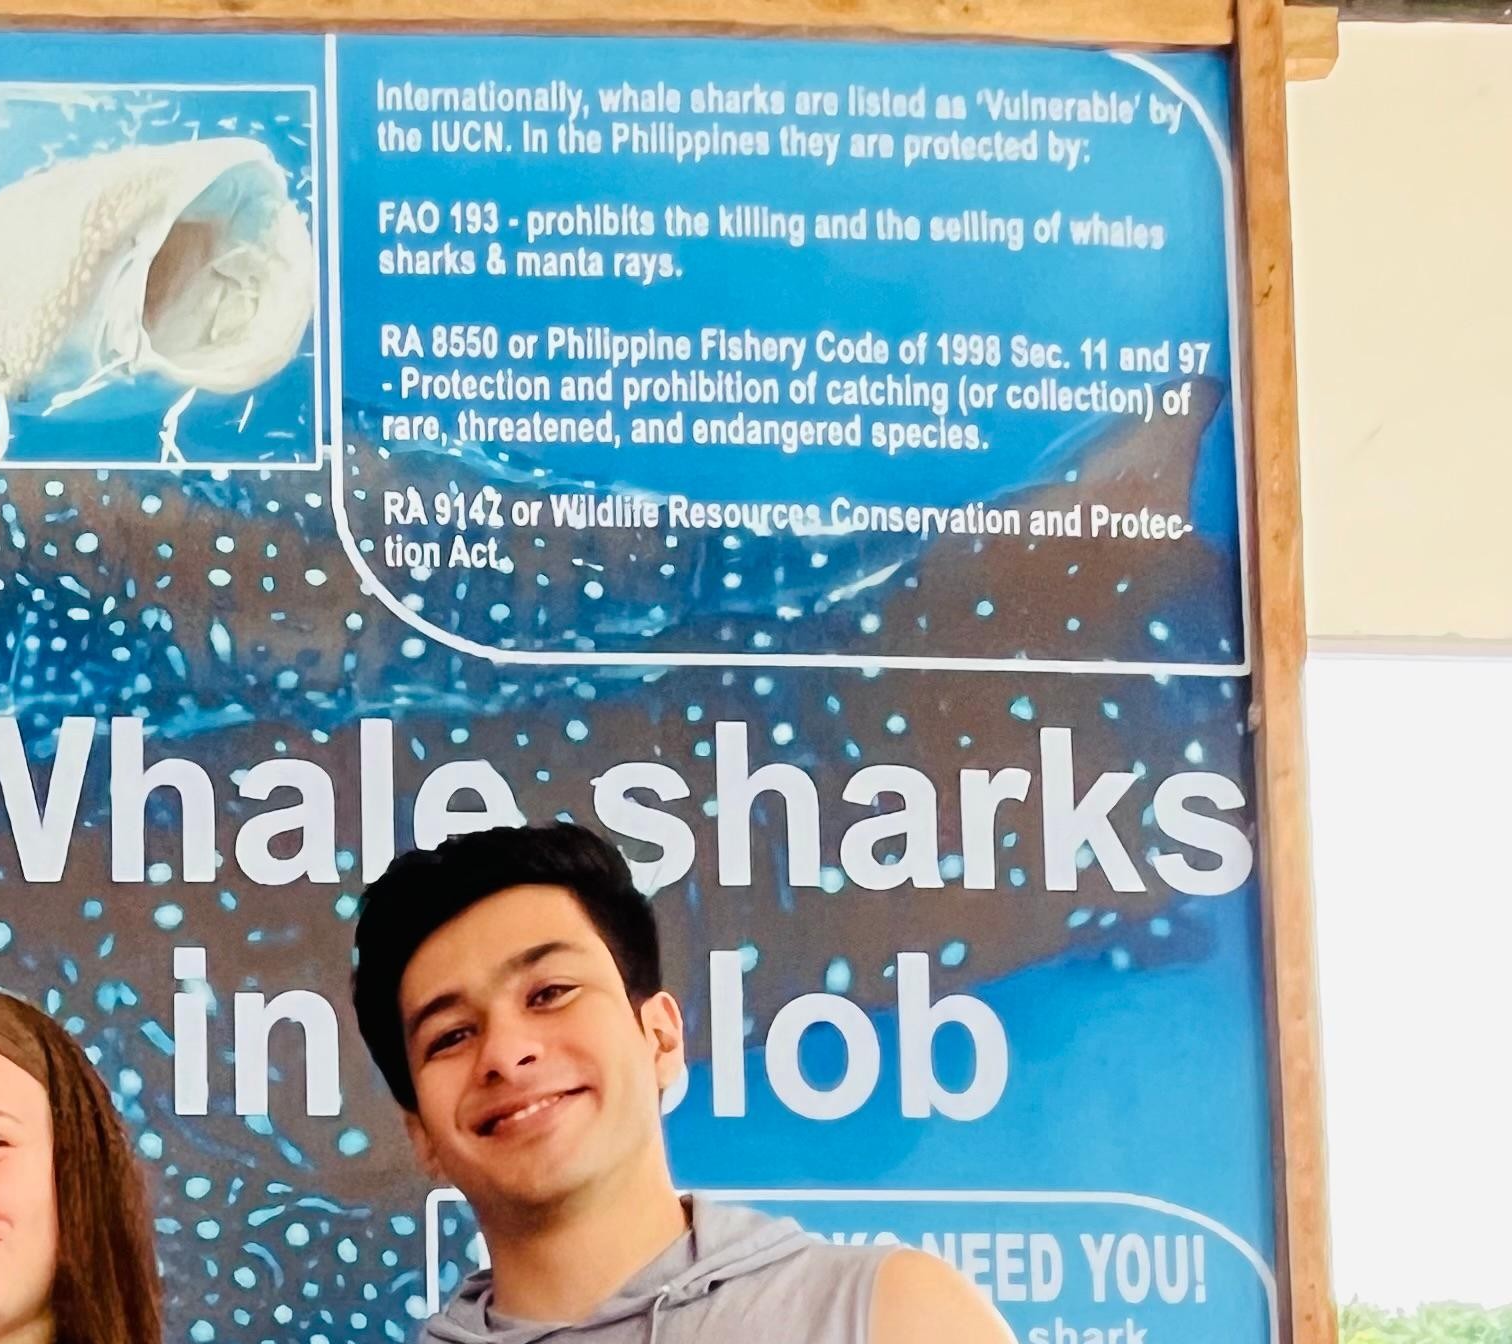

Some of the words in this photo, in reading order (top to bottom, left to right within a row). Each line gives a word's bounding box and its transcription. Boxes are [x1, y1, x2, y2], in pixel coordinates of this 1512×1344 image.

[376, 79, 589, 121] Internationally,
[599, 82, 681, 113] whale
[691, 82, 785, 115] sharks
[795, 90, 838, 116] are
[848, 84, 925, 119] listed
[936, 95, 967, 120] as
[1150, 94, 1184, 135] by
[377, 120, 421, 154] the
[432, 121, 512, 153] IUCN.
[523, 120, 547, 154] In
[558, 122, 601, 154] the
[612, 122, 769, 163] Philippines
[780, 124, 840, 166] they
[850, 133, 894, 159] are
[904, 130, 1038, 168] protected
[1048, 130, 1090, 171] by:
[378, 201, 440, 234] FAO
[450, 201, 499, 234] 193
[528, 204, 655, 243] prohibits
[665, 205, 709, 236] the
[720, 205, 805, 247] killing
[815, 208, 866, 241] and
[876, 209, 921, 241] the
[930, 210, 1024, 251] selling
[1033, 211, 1061, 243] of
[1070, 213, 1165, 250] whales
[378, 242, 475, 275] sharks
[487, 243, 506, 275] &
[517, 246, 603, 277] manta
[614, 250, 682, 286] rays.
[381, 324, 424, 359] RA
[432, 326, 498, 359] 8550
[508, 334, 538, 359] or
[548, 327, 690, 367] Philippine
[701, 328, 806, 370] Fishery
[816, 330, 888, 364] Code
[899, 333, 927, 364] of
[937, 334, 1001, 367] 1998
[1010, 335, 1071, 369] Sec.
[1081, 339, 1107, 370] 11
[1120, 342, 1169, 373] and
[1179, 343, 1210, 375] 97
[401, 367, 550, 400] Protection
[561, 370, 612, 400] and
[623, 370, 778, 409] prohibition
[790, 371, 817, 402] of
[826, 374, 949, 415] catching
[959, 375, 997, 415] (or
[1007, 379, 1153, 423] collection)
[1162, 383, 1191, 415] of
[383, 414, 447, 446] rare,
[458, 410, 621, 448] threatened,
[631, 412, 682, 445] and
[693, 412, 861, 453] endangered
[872, 414, 989, 455] species.
[384, 488, 427, 526] RA
[512, 500, 542, 527] or
[550, 495, 659, 529] Wildlife
[669, 495, 821, 531] Resources
[831, 498, 1020, 535] Conservation
[1029, 505, 1081, 537] and
[1091, 505, 1193, 540] Protec-
[384, 534, 440, 568] tion
[589, 722, 1255, 896] sharks
[173, 946, 342, 1118] in
[661, 950, 1009, 1121] lob
[1080, 1233, 1206, 1304] YOU!
